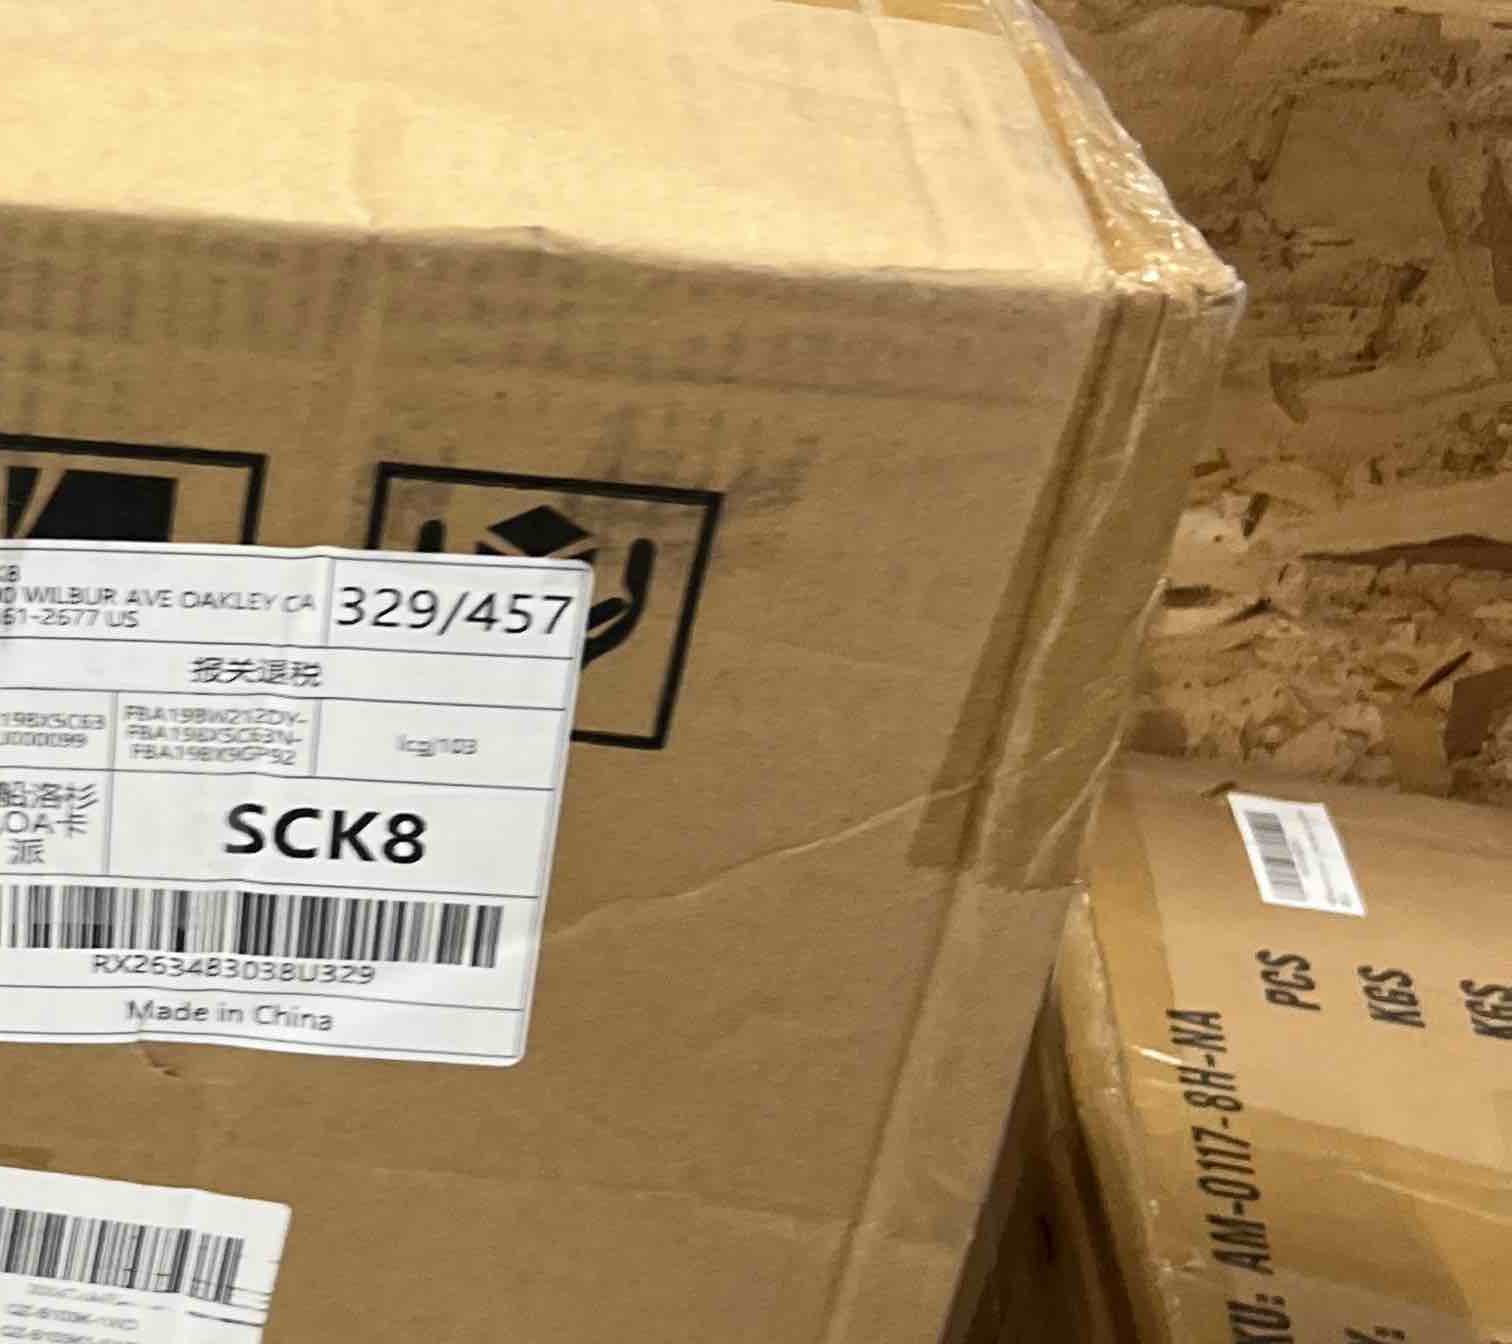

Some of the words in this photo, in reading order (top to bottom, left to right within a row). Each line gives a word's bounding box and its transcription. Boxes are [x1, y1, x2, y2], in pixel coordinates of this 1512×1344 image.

[23, 587, 116, 606] WILBUR
[125, 588, 172, 608] AVE
[179, 590, 274, 611] OAKLEY
[281, 593, 316, 613] CA
[105, 610, 139, 628] US
[336, 585, 573, 636] 329/457
[225, 803, 427, 865] SCK8
[1255, 949, 1321, 1012] PCS
[1357, 965, 1426, 1029] KGS
[126, 999, 208, 1024] Made
[216, 1003, 244, 1023] in
[253, 1004, 333, 1032] China
